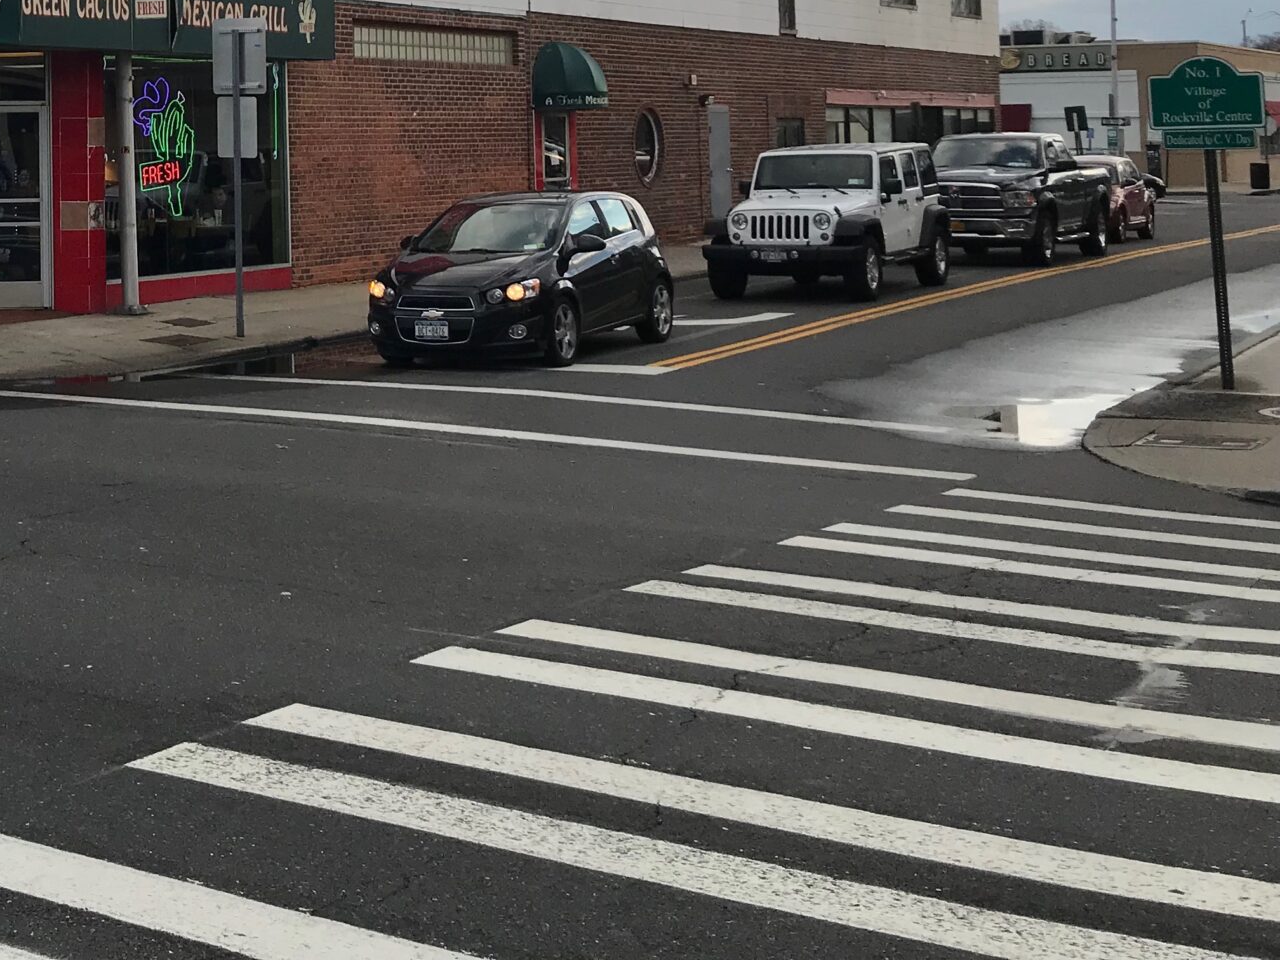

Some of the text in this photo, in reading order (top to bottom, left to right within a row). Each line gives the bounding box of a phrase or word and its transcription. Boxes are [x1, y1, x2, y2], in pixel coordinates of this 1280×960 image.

[136, 0, 166, 17] FRESH
[1027, 52, 1105, 67] BREAD
[1185, 66, 1210, 79] No.
[1184, 87, 1227, 97] Village
[545, 97, 553, 106] A
[1197, 98, 1213, 110] of
[1162, 111, 1253, 123] Rockville Centre
[141, 161, 181, 188] FRESH
